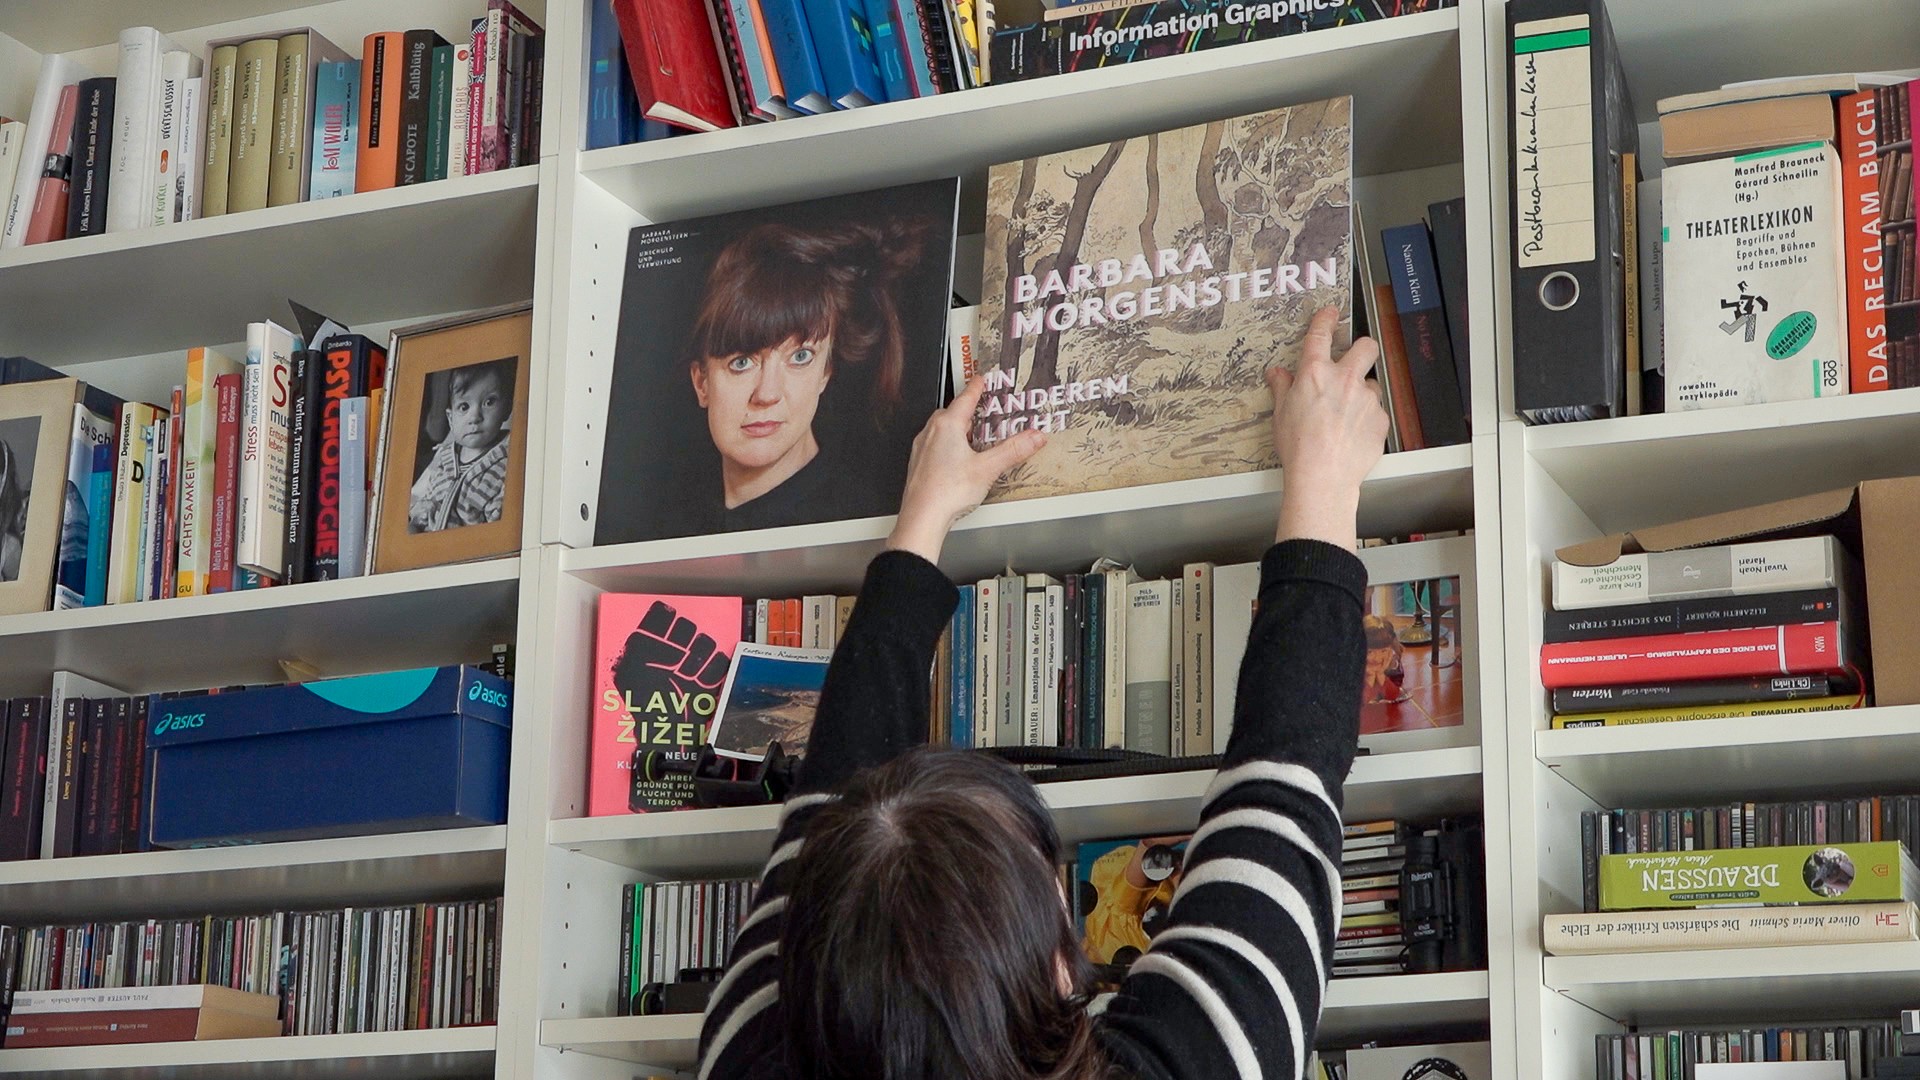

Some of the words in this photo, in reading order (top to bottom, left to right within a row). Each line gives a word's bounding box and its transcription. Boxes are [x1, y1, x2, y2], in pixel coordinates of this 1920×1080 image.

[1069, 12, 1219, 52] Information
[1224, 0, 1346, 26] Graphics
[243, 60, 253, 82] Werk
[282, 55, 292, 77] Werk
[408, 41, 426, 100] Kaltblütig
[212, 66, 222, 89] Werk
[242, 84, 250, 100] Das
[282, 79, 291, 95] Das
[212, 90, 220, 106] Das
[90, 106, 100, 118] der
[240, 103, 249, 125] Keun
[280, 98, 290, 120] Keun
[453, 86, 469, 131] AUERHAUS
[89, 118, 99, 134] Ende
[209, 109, 219, 131] Keun
[323, 103, 344, 145] WOLFE
[238, 126, 249, 159] Irmgard
[278, 121, 289, 155] Irmgard
[1856, 98, 1880, 178] BUCH
[207, 132, 218, 165] Irmgard
[405, 123, 418, 172] CAPOTE
[1734, 162, 1777, 178] Manfred
[1780, 152, 1826, 169] Brauneck
[83, 170, 94, 194] Hansen
[1734, 175, 1770, 190] Gérard
[1773, 167, 1819, 184] Schneilin
[1734, 190, 1760, 204] (Hg.)
[80, 216, 90, 232] Erik
[1686, 205, 1814, 240] THEATERLEXIKON
[640, 232, 689, 245] MORGENSTERN
[641, 229, 671, 239] BARBARA
[1736, 231, 1777, 248] Begriffe
[1778, 229, 1797, 242] und
[1651, 240, 1661, 265] Lupo
[1736, 244, 1780, 261] Epochen,
[1780, 240, 1817, 254] Bühnen
[1860, 191, 1886, 312] RECLAM
[638, 256, 653, 264] UND
[1736, 259, 1755, 273] und
[1758, 253, 1809, 270] Ensembles
[1013, 242, 1214, 305] BARBARA
[1402, 243, 1415, 278] Naomi
[1409, 278, 1422, 305] Klein
[1651, 267, 1661, 311] Salvatore
[1010, 257, 1338, 340] MORGENSTERN
[1866, 323, 1889, 384] DAS
[297, 359, 305, 378] Boss
[1823, 359, 1838, 369] ro
[251, 368, 260, 384] sein
[983, 367, 1016, 393] IN
[1823, 368, 1838, 378] ro
[1823, 376, 1839, 387] ro
[248, 385, 260, 403] nicht
[1678, 381, 1718, 391] rowohlts
[979, 373, 1131, 420] ANDEREM
[1678, 388, 1739, 402] enzyklopädie
[227, 386, 238, 423] Grönemeyer
[250, 404, 258, 424] muss
[293, 396, 305, 436] Verlust,
[120, 413, 131, 457] Depression
[980, 409, 1073, 445] LICHT
[244, 425, 259, 462] Stress
[292, 435, 304, 474] Trauma
[315, 350, 353, 558] PSYCHOLOGIE
[291, 477, 302, 496] und
[182, 460, 196, 557] ACHTSAMKEIT
[213, 495, 225, 549] Rückenbuch
[288, 498, 301, 543] Resilienz
[212, 550, 222, 571] Mein
[1738, 557, 1767, 567] Harari
[1763, 563, 1789, 574] Yuval
[1592, 564, 1642, 577] Menschheit
[1595, 573, 1643, 584] Geschichte
[1738, 565, 1762, 576] Noah
[178, 584, 192, 594] GU
[1579, 576, 1593, 586] der
[1598, 581, 1622, 593] kurze
[1622, 581, 1642, 591] Eine
[1031, 604, 1042, 631] Gruppe
[1652, 615, 1672, 625] DAS
[1684, 610, 1721, 622] KOLBERT
[1722, 607, 1768, 618] ELIZABETH
[1568, 620, 1609, 631] STERBEN
[1611, 616, 1651, 627] SECHSTE
[1032, 633, 1041, 645] der
[1757, 643, 1777, 652] DAS
[1032, 647, 1040, 655] in
[1597, 653, 1628, 663] ULRIKE
[1646, 648, 1712, 660] KAPITALISMUS
[1712, 646, 1731, 656] DES
[1732, 644, 1756, 655] ENDE
[1547, 654, 1596, 666] HERRMANN
[1031, 657, 1041, 705] Emanzipation
[1771, 677, 1810, 690] Ch.Links
[481, 687, 508, 708] asics
[1572, 686, 1614, 700] Warten
[1174, 701, 1182, 720] Kunst
[171, 713, 206, 730] asics
[65, 720, 76, 751] Erfahrung
[665, 751, 698, 761] NEUE
[63, 780, 71, 801] Dewey
[636, 781, 674, 791] GRÜNDE
[676, 781, 695, 791] FÜR
[636, 789, 672, 799] FLUCHT
[674, 791, 695, 799] UND
[647, 798, 684, 807] TERROR
[1642, 863, 1780, 892] DRAUSSEN
[1615, 921, 1660, 936] Kritiker
[1661, 918, 1719, 935] schärfsten
[1721, 919, 1741, 931] Die
[1749, 917, 1790, 930] Schmitt
[1792, 916, 1826, 929] Maria
[1828, 914, 1861, 927] Oliver
[1560, 924, 1591, 938] Elche
[1595, 923, 1615, 937] der
[106, 994, 131, 1004] AUSTER
[132, 994, 150, 1003] PAUL
